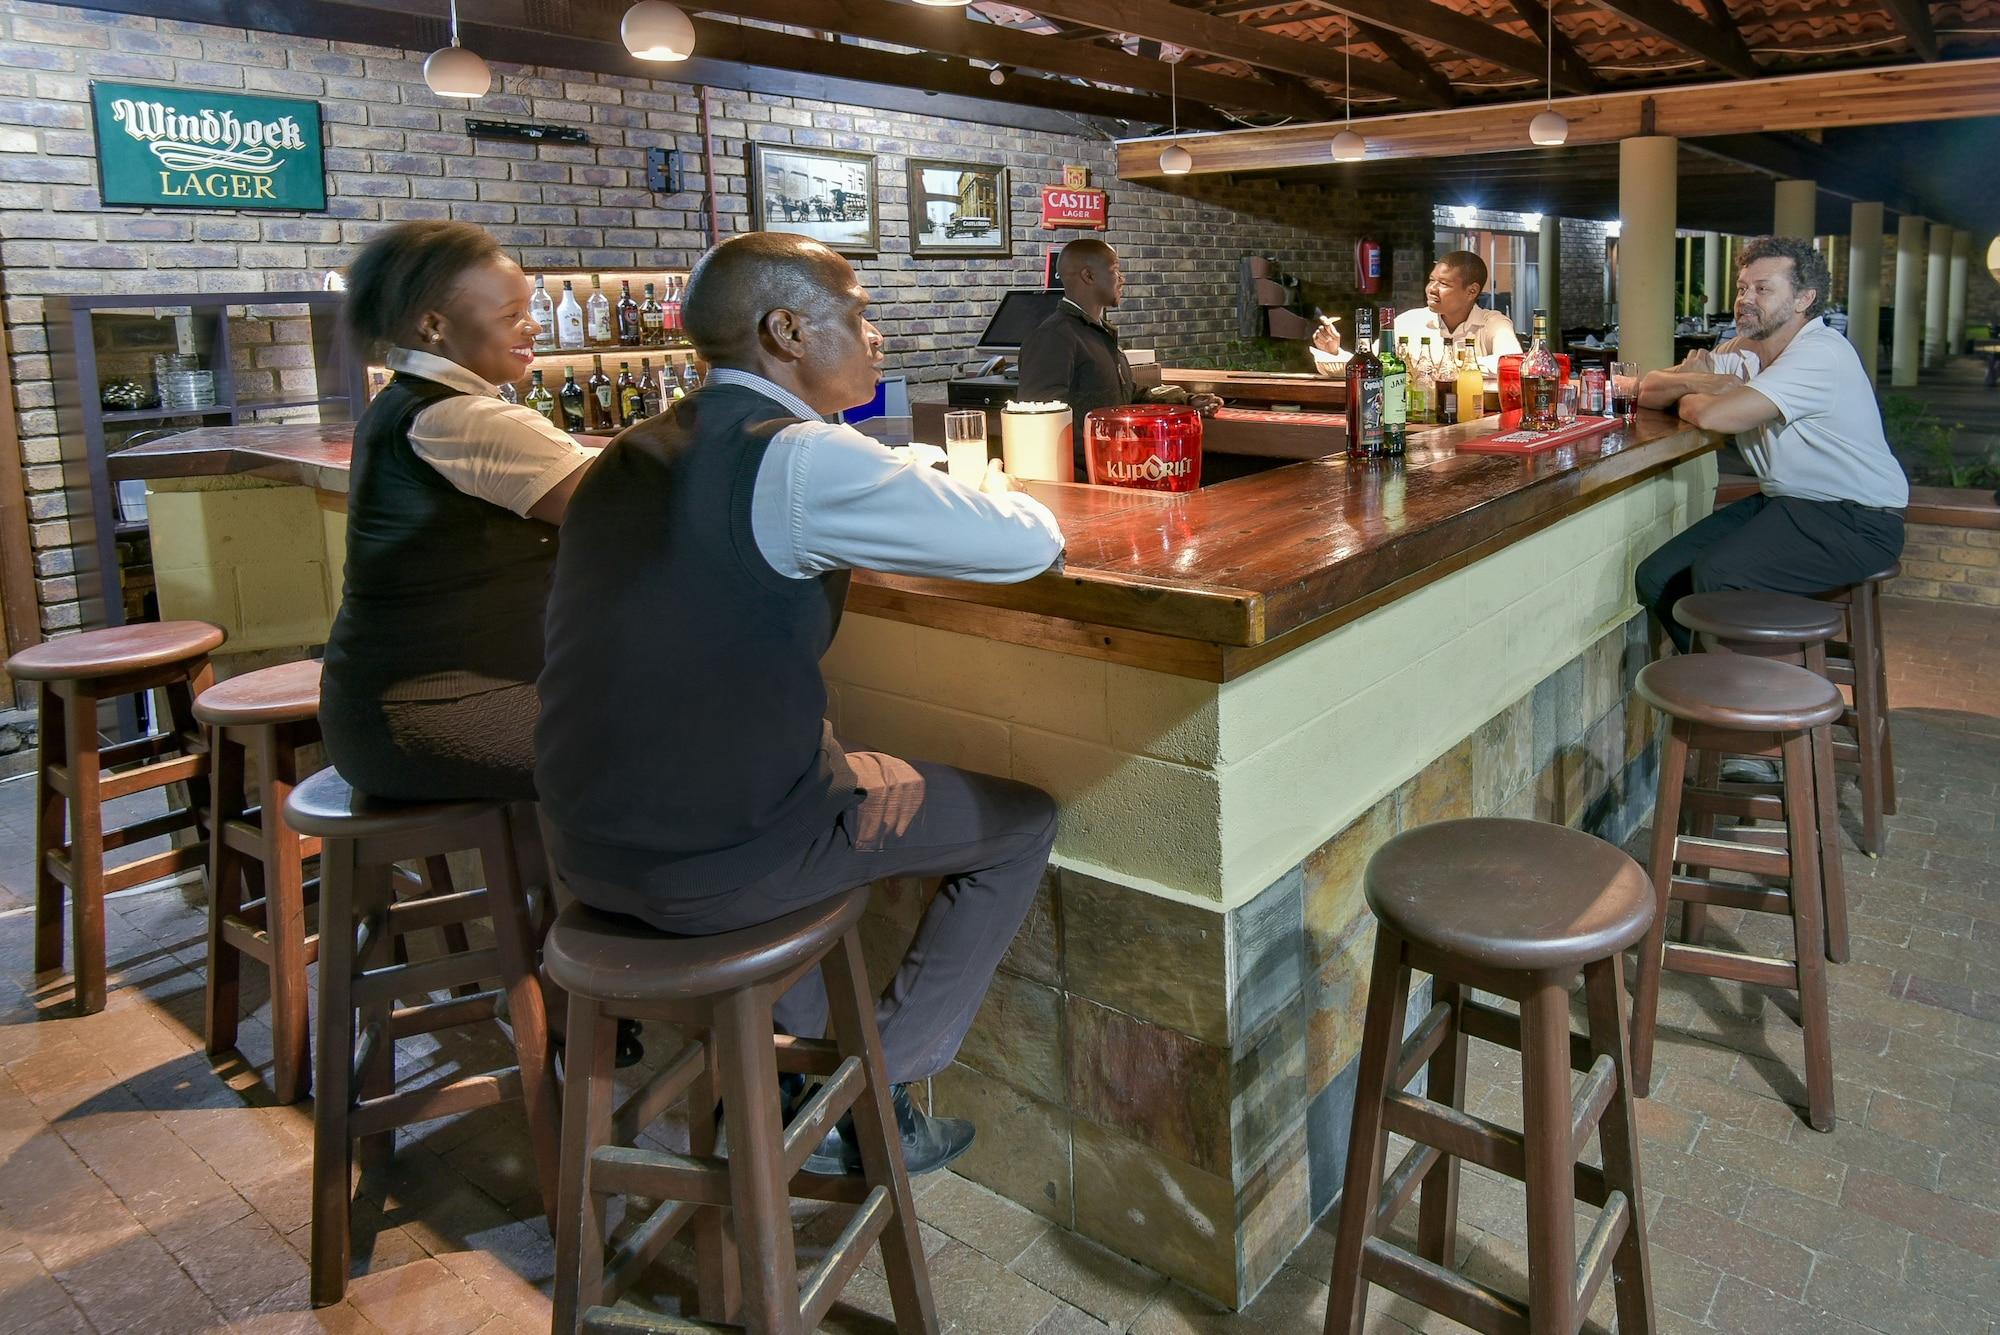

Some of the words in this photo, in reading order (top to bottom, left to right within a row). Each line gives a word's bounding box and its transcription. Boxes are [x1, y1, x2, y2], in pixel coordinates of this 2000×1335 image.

[111, 98, 306, 153] Windhoek
[159, 171, 276, 199] LAGER
[1048, 192, 1100, 210] CASTLE
[1062, 210, 1090, 218] LAGER
[1390, 377, 1407, 389] JAM
